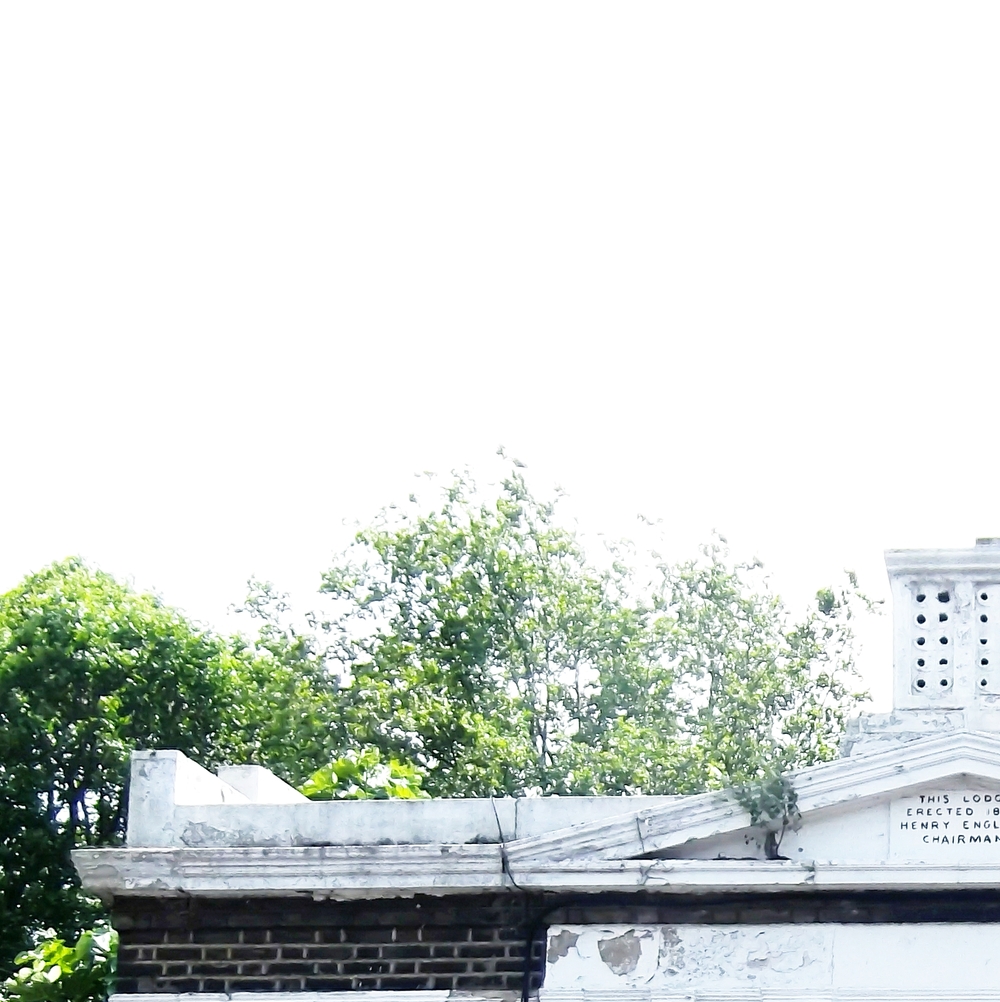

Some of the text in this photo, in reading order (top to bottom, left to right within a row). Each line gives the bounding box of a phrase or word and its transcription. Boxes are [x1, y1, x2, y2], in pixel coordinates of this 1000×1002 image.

[919, 794, 950, 804] THIS
[906, 807, 974, 817] ERECTED
[900, 821, 950, 830] HENRY
